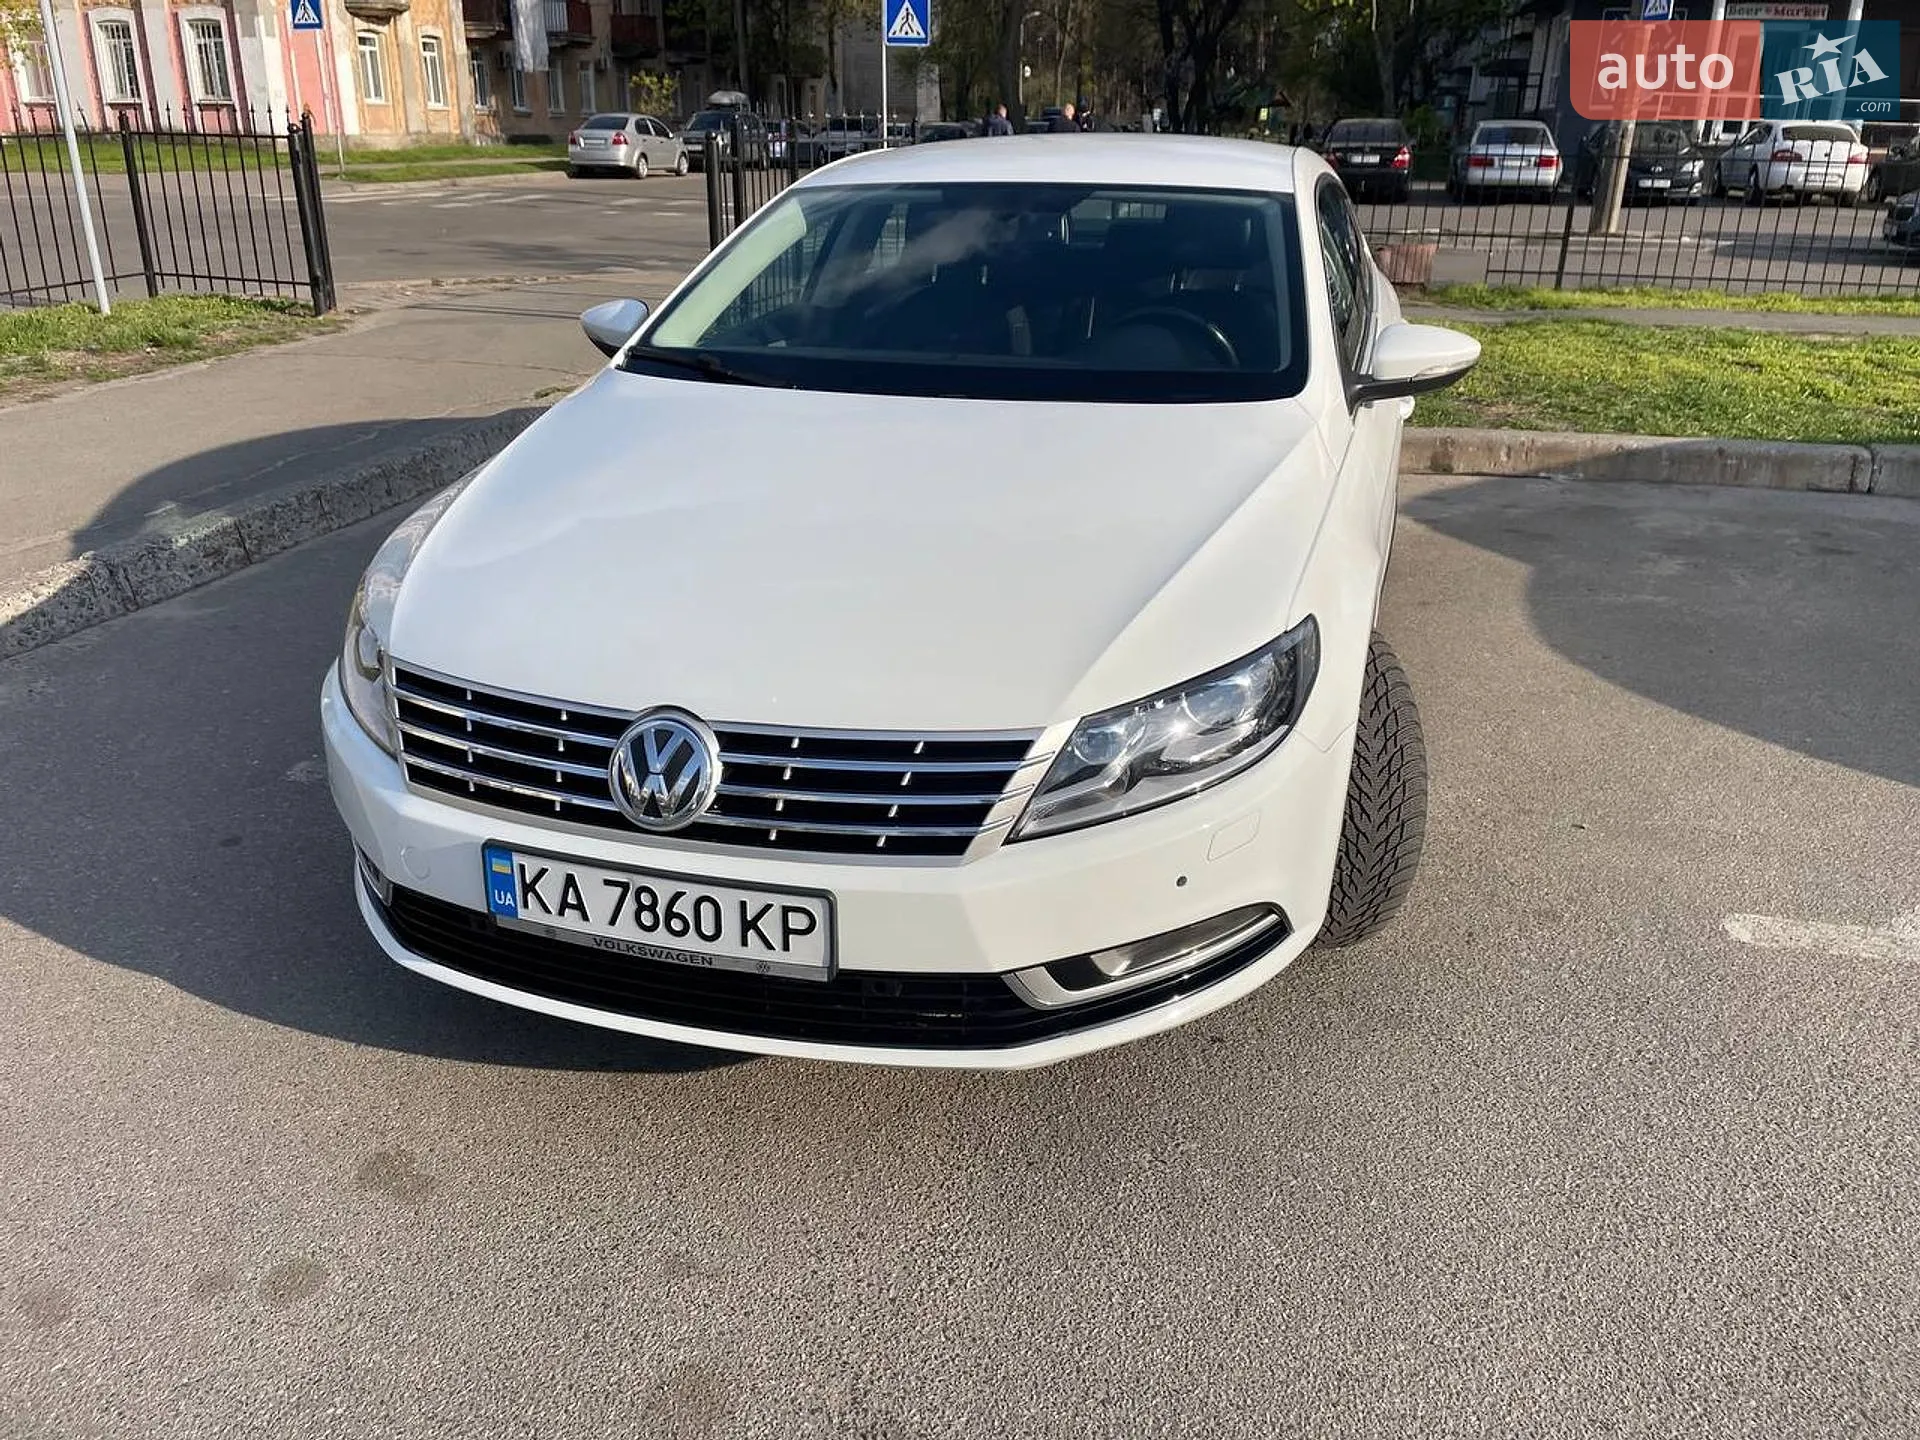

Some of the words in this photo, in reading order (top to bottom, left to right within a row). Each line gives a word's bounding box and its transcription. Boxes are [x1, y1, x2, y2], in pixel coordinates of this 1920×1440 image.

[494, 889, 515, 907] UA
[518, 862, 591, 922] KA
[602, 878, 723, 942] 7860
[739, 899, 818, 952] KP
[593, 936, 713, 966] VOLKSWAGEN
